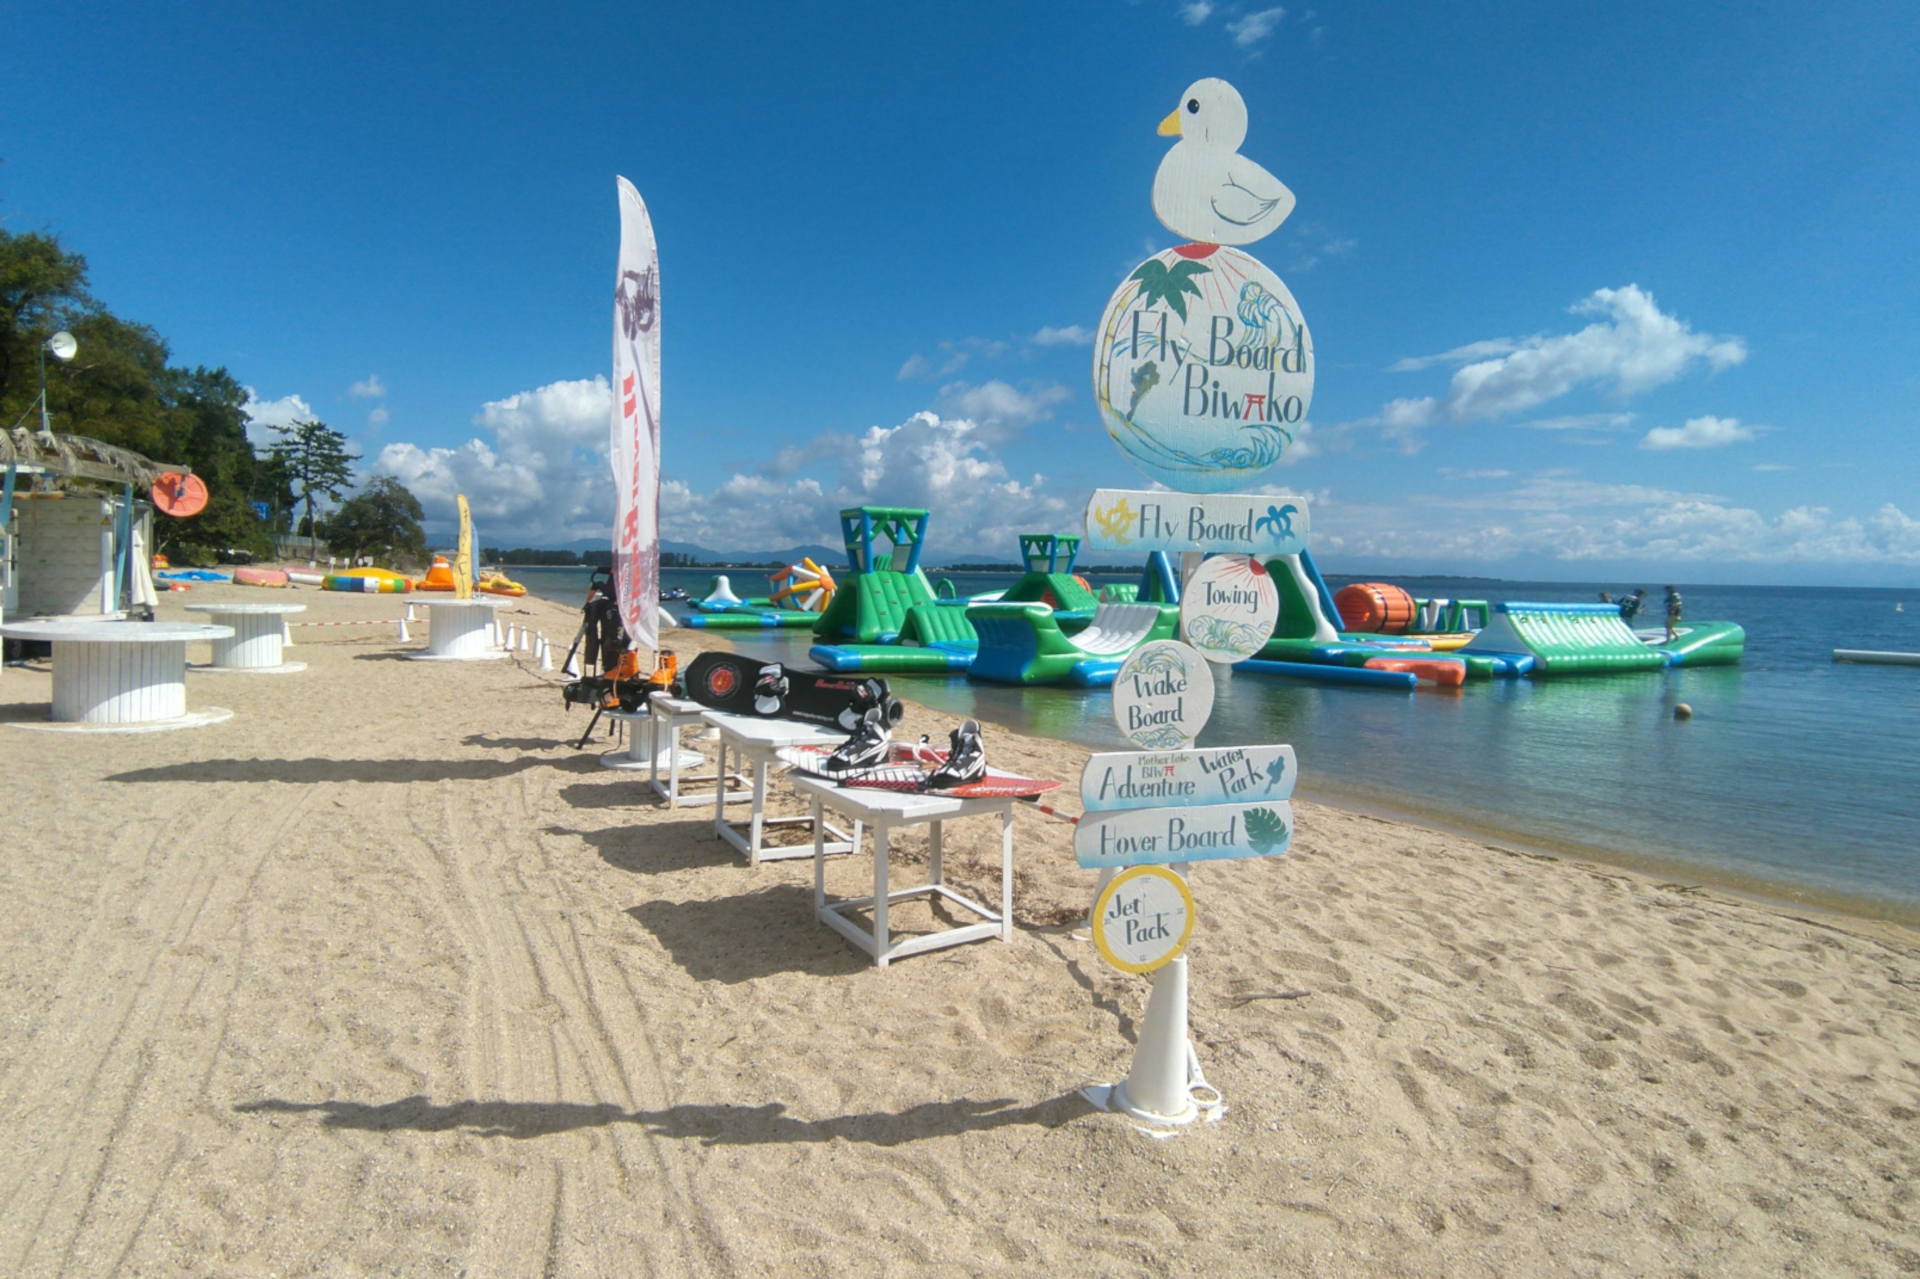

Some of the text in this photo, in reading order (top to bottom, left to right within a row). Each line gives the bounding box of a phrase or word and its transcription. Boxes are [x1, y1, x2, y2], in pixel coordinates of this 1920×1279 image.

[1131, 310, 1307, 386] Fly Board
[1138, 503, 1254, 549] Fly Board
[1203, 580, 1259, 614] Towing
[1133, 671, 1188, 699] Wake
[1128, 697, 1184, 731] Board
[1138, 754, 1169, 766] Mother
[1198, 748, 1248, 775] Water
[1098, 764, 1196, 801] Adventure
[1218, 757, 1265, 800] Park
[1100, 815, 1236, 855] Hover Board
[1108, 893, 1142, 919] Jet
[1126, 912, 1170, 946] Pack
